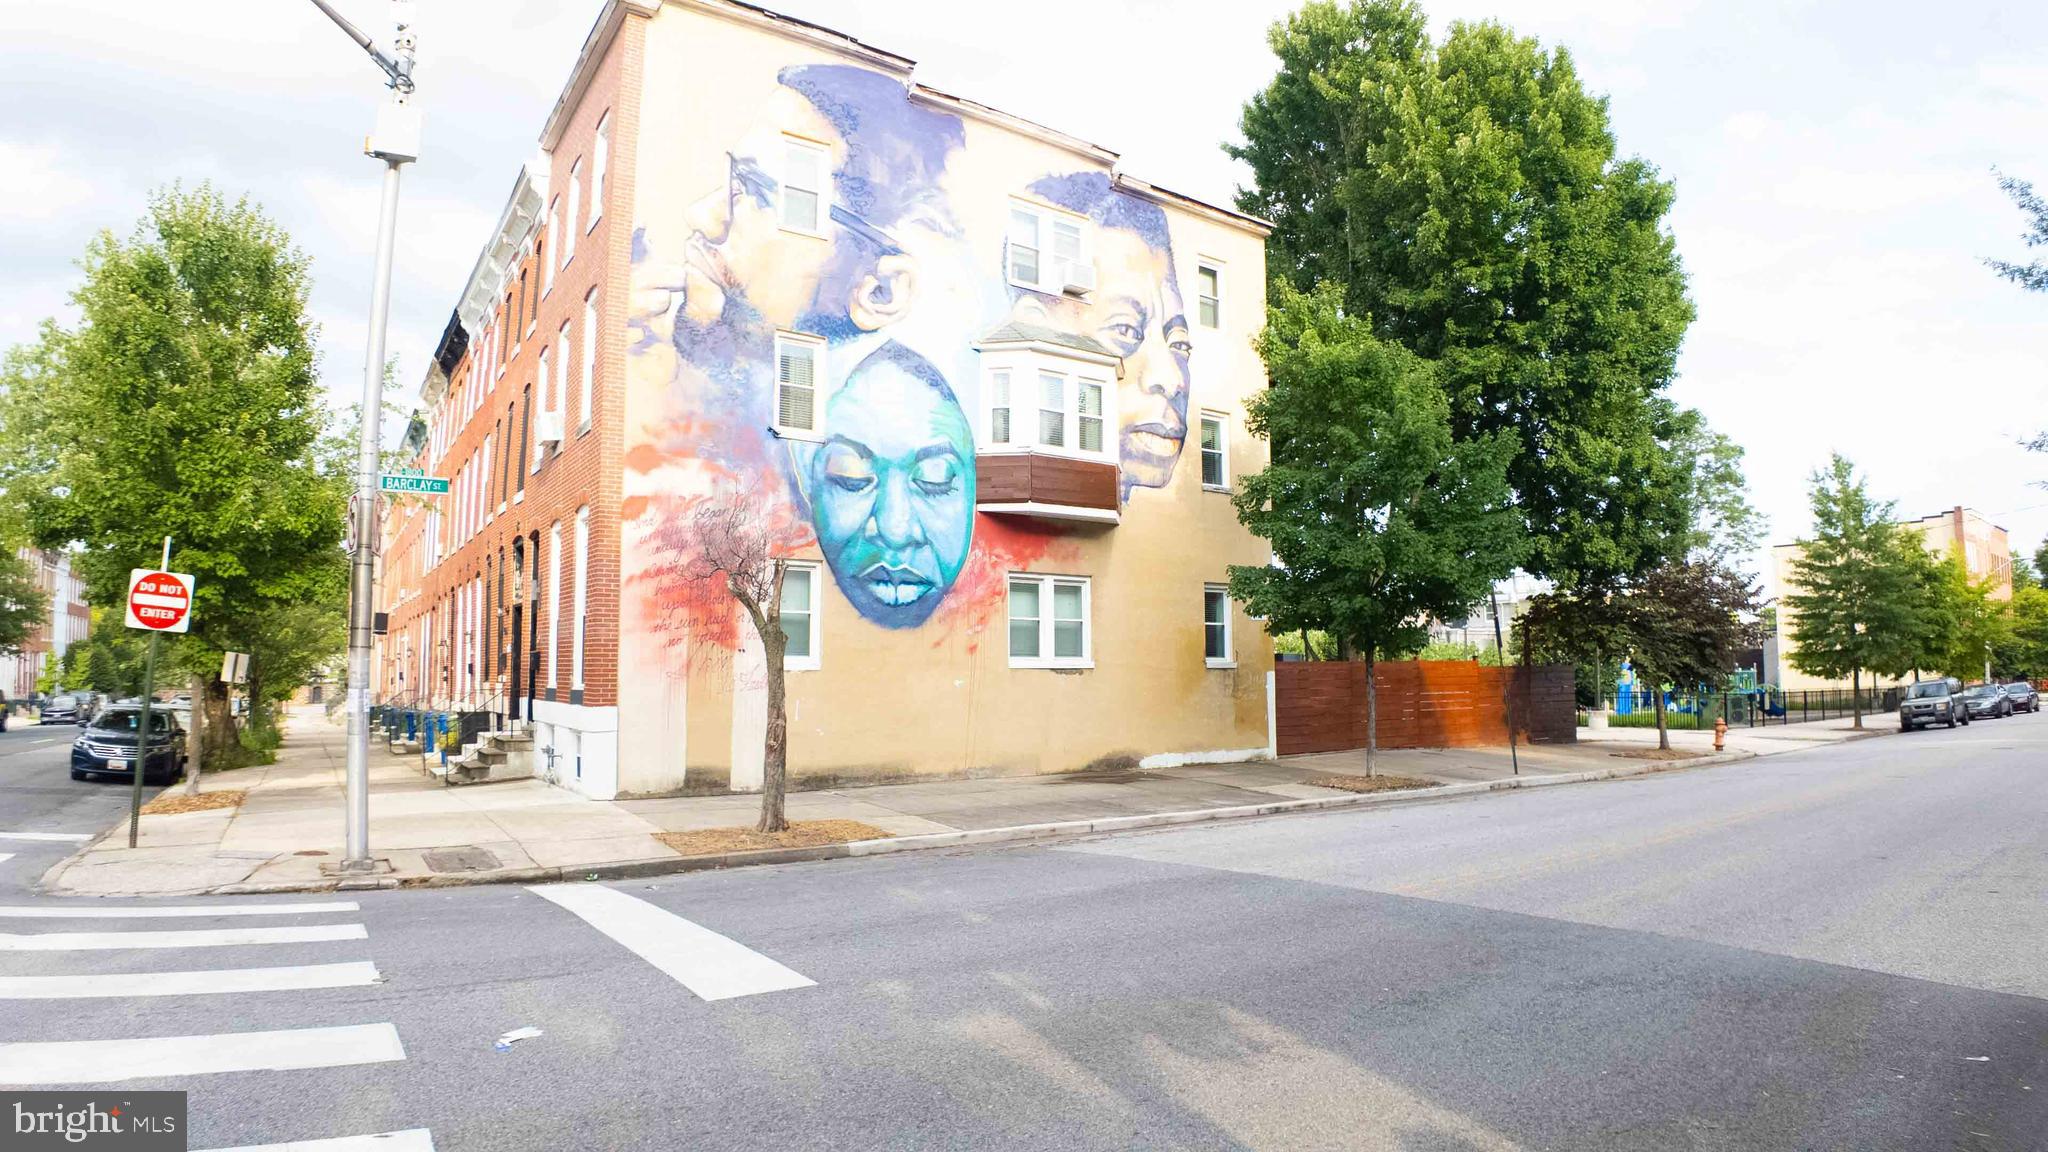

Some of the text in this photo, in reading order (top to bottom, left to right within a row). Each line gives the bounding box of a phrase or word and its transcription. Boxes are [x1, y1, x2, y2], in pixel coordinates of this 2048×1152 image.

[386, 477, 433, 491] BARCLAY
[139, 582, 184, 595] DO NOT
[140, 607, 176, 620] ENTER
